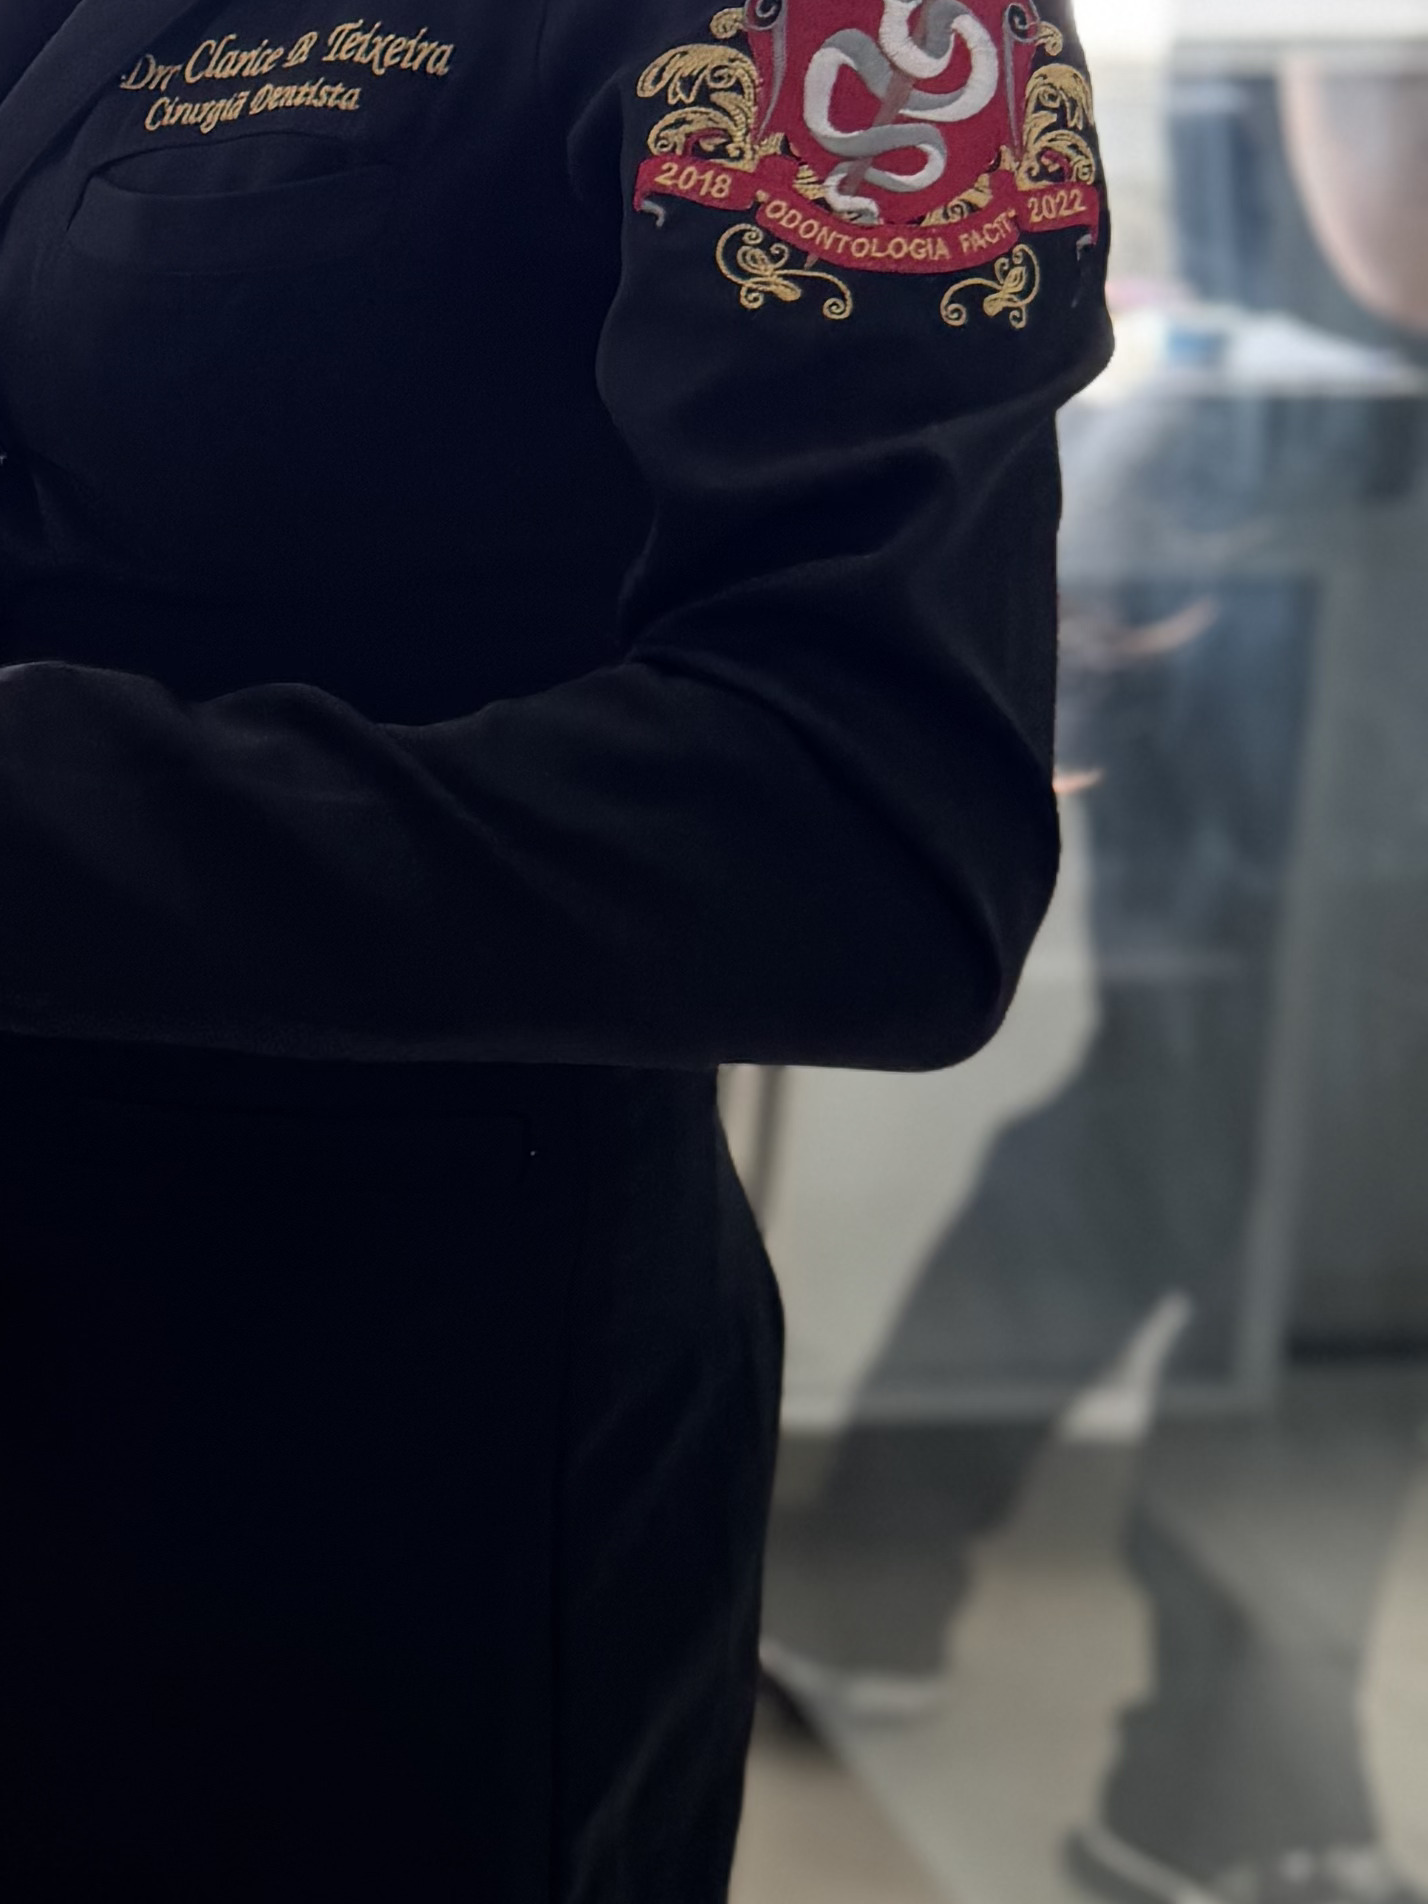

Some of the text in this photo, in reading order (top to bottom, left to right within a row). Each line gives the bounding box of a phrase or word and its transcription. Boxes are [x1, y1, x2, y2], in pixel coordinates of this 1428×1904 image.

[184, 33, 285, 84] Clarice
[321, 18, 455, 76] Teixeira
[249, 76, 362, 116] Dentista
[654, 162, 733, 198] 2018
[1027, 188, 1088, 223] 2022
